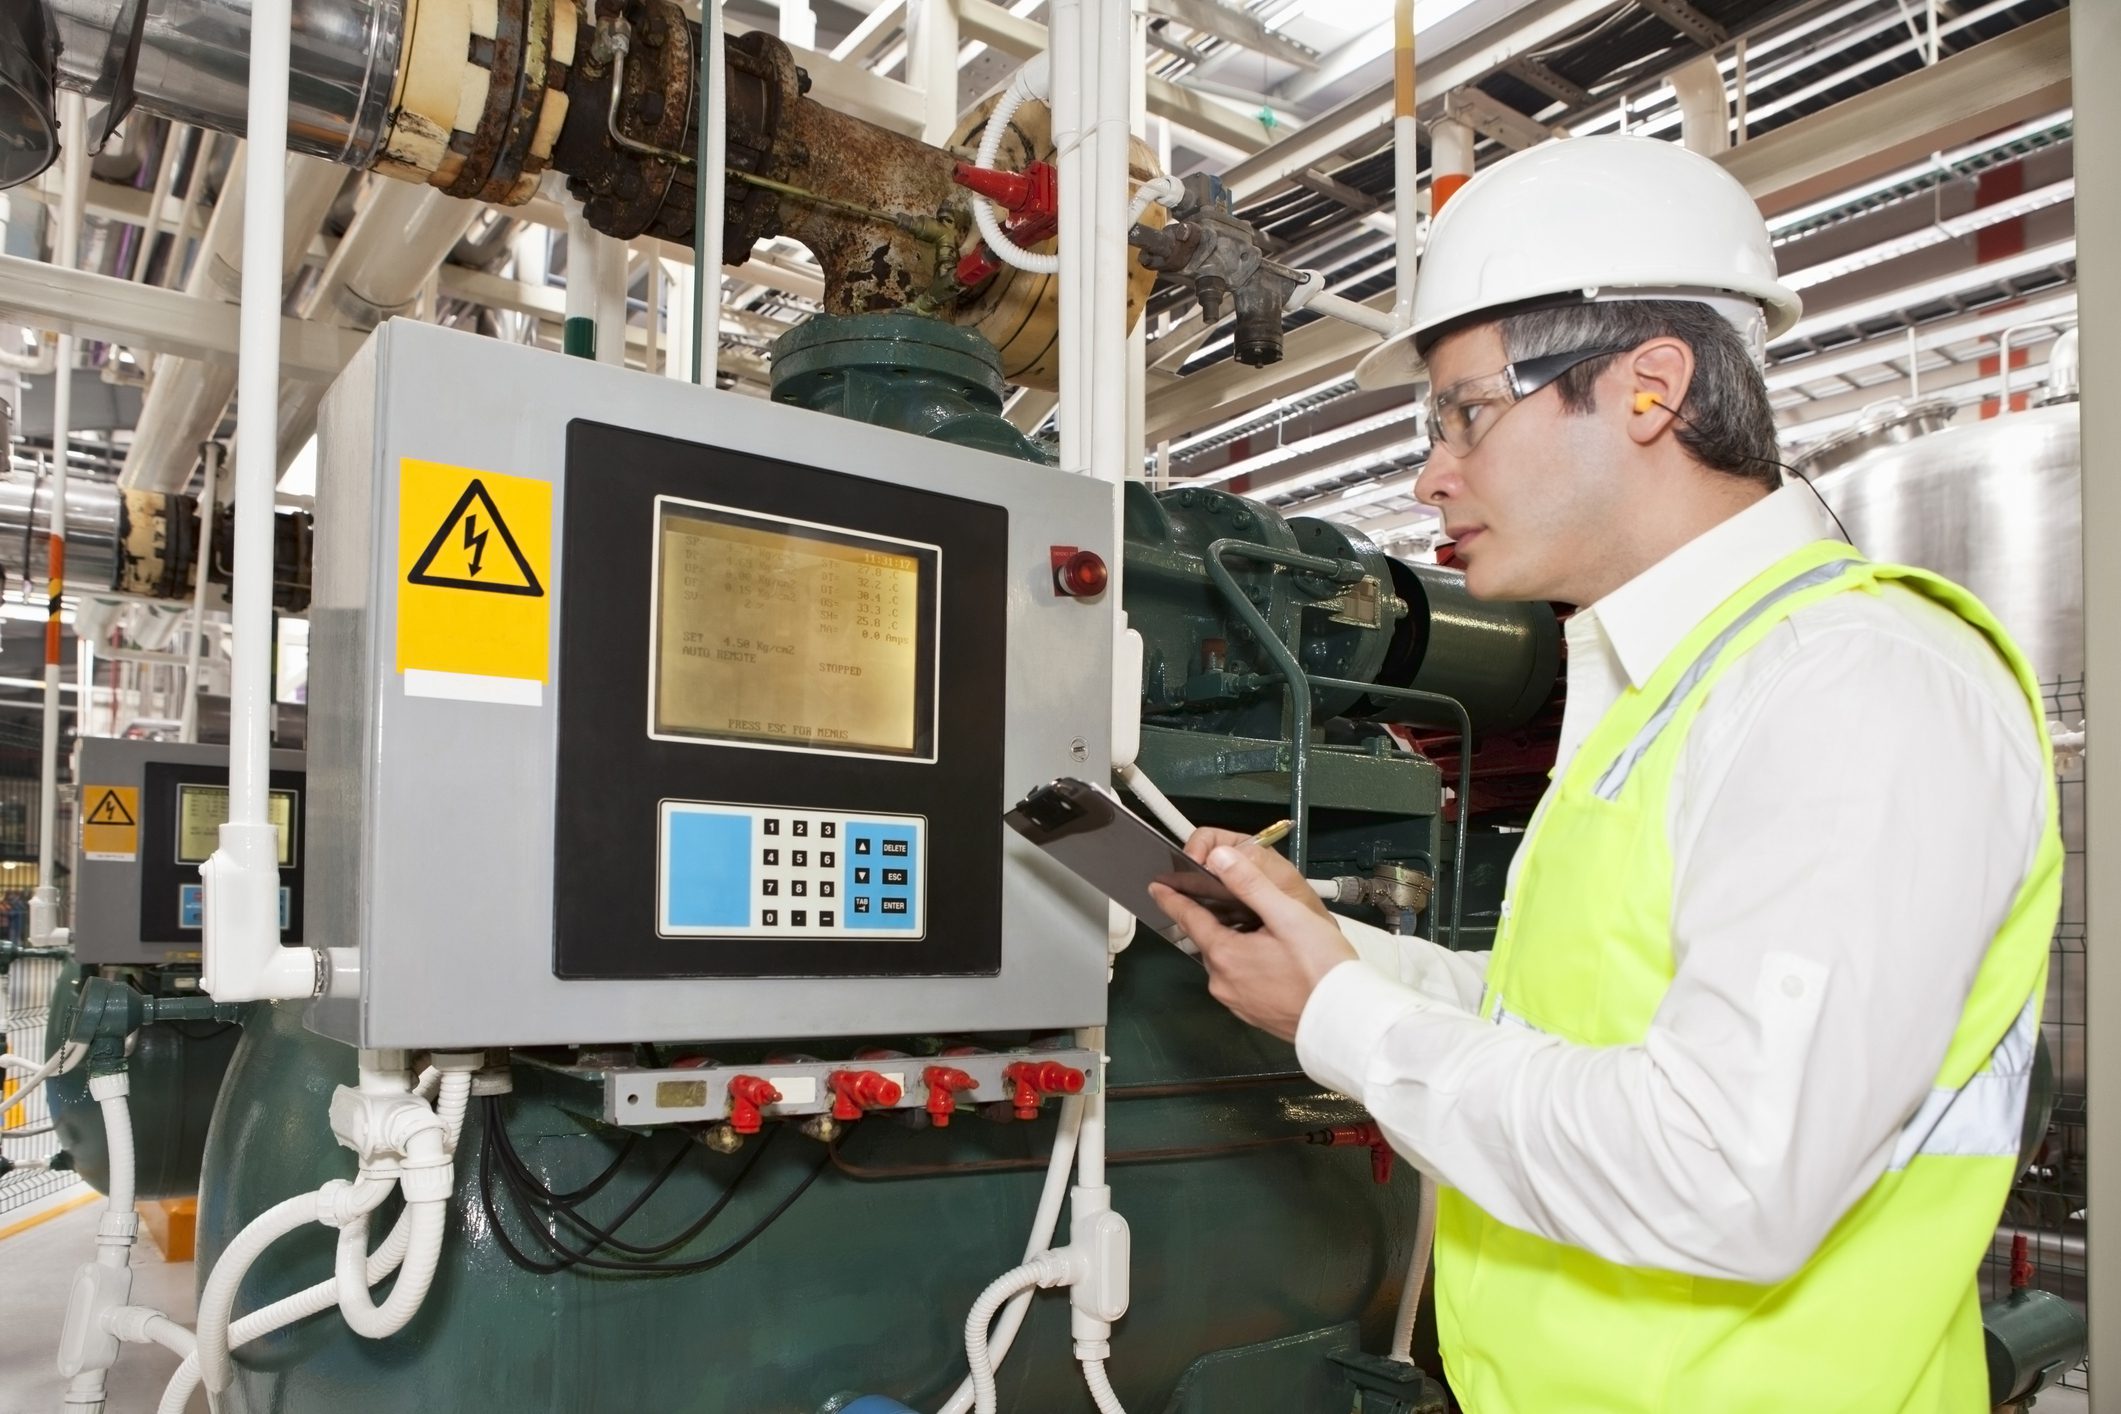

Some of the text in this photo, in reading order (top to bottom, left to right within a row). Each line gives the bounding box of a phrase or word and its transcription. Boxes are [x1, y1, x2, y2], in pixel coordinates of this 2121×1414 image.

[865, 553, 911, 569] 11:31:17
[857, 565, 881, 577] 27.8
[857, 578, 881, 590] 32.2
[856, 604, 881, 615] 33.3
[856, 615, 881, 628] 25.8
[682, 631, 796, 656] SET 4.50 Kg/cm2
[862, 629, 880, 641] 0.0
[885, 633, 909, 646] Amps
[682, 645, 757, 664] AUTO REMOTE
[819, 662, 862, 677] STOPPED
[728, 719, 849, 740] PRESS ESC FOR MENUS
[769, 822, 832, 835] 1 2 3
[883, 844, 907, 853] DELETE
[767, 852, 831, 865] 4 5 6
[887, 872, 902, 881] ESC
[767, 882, 831, 894] 7 8 9
[883, 901, 905, 910] ENTER
[766, 913, 774, 923] 0
